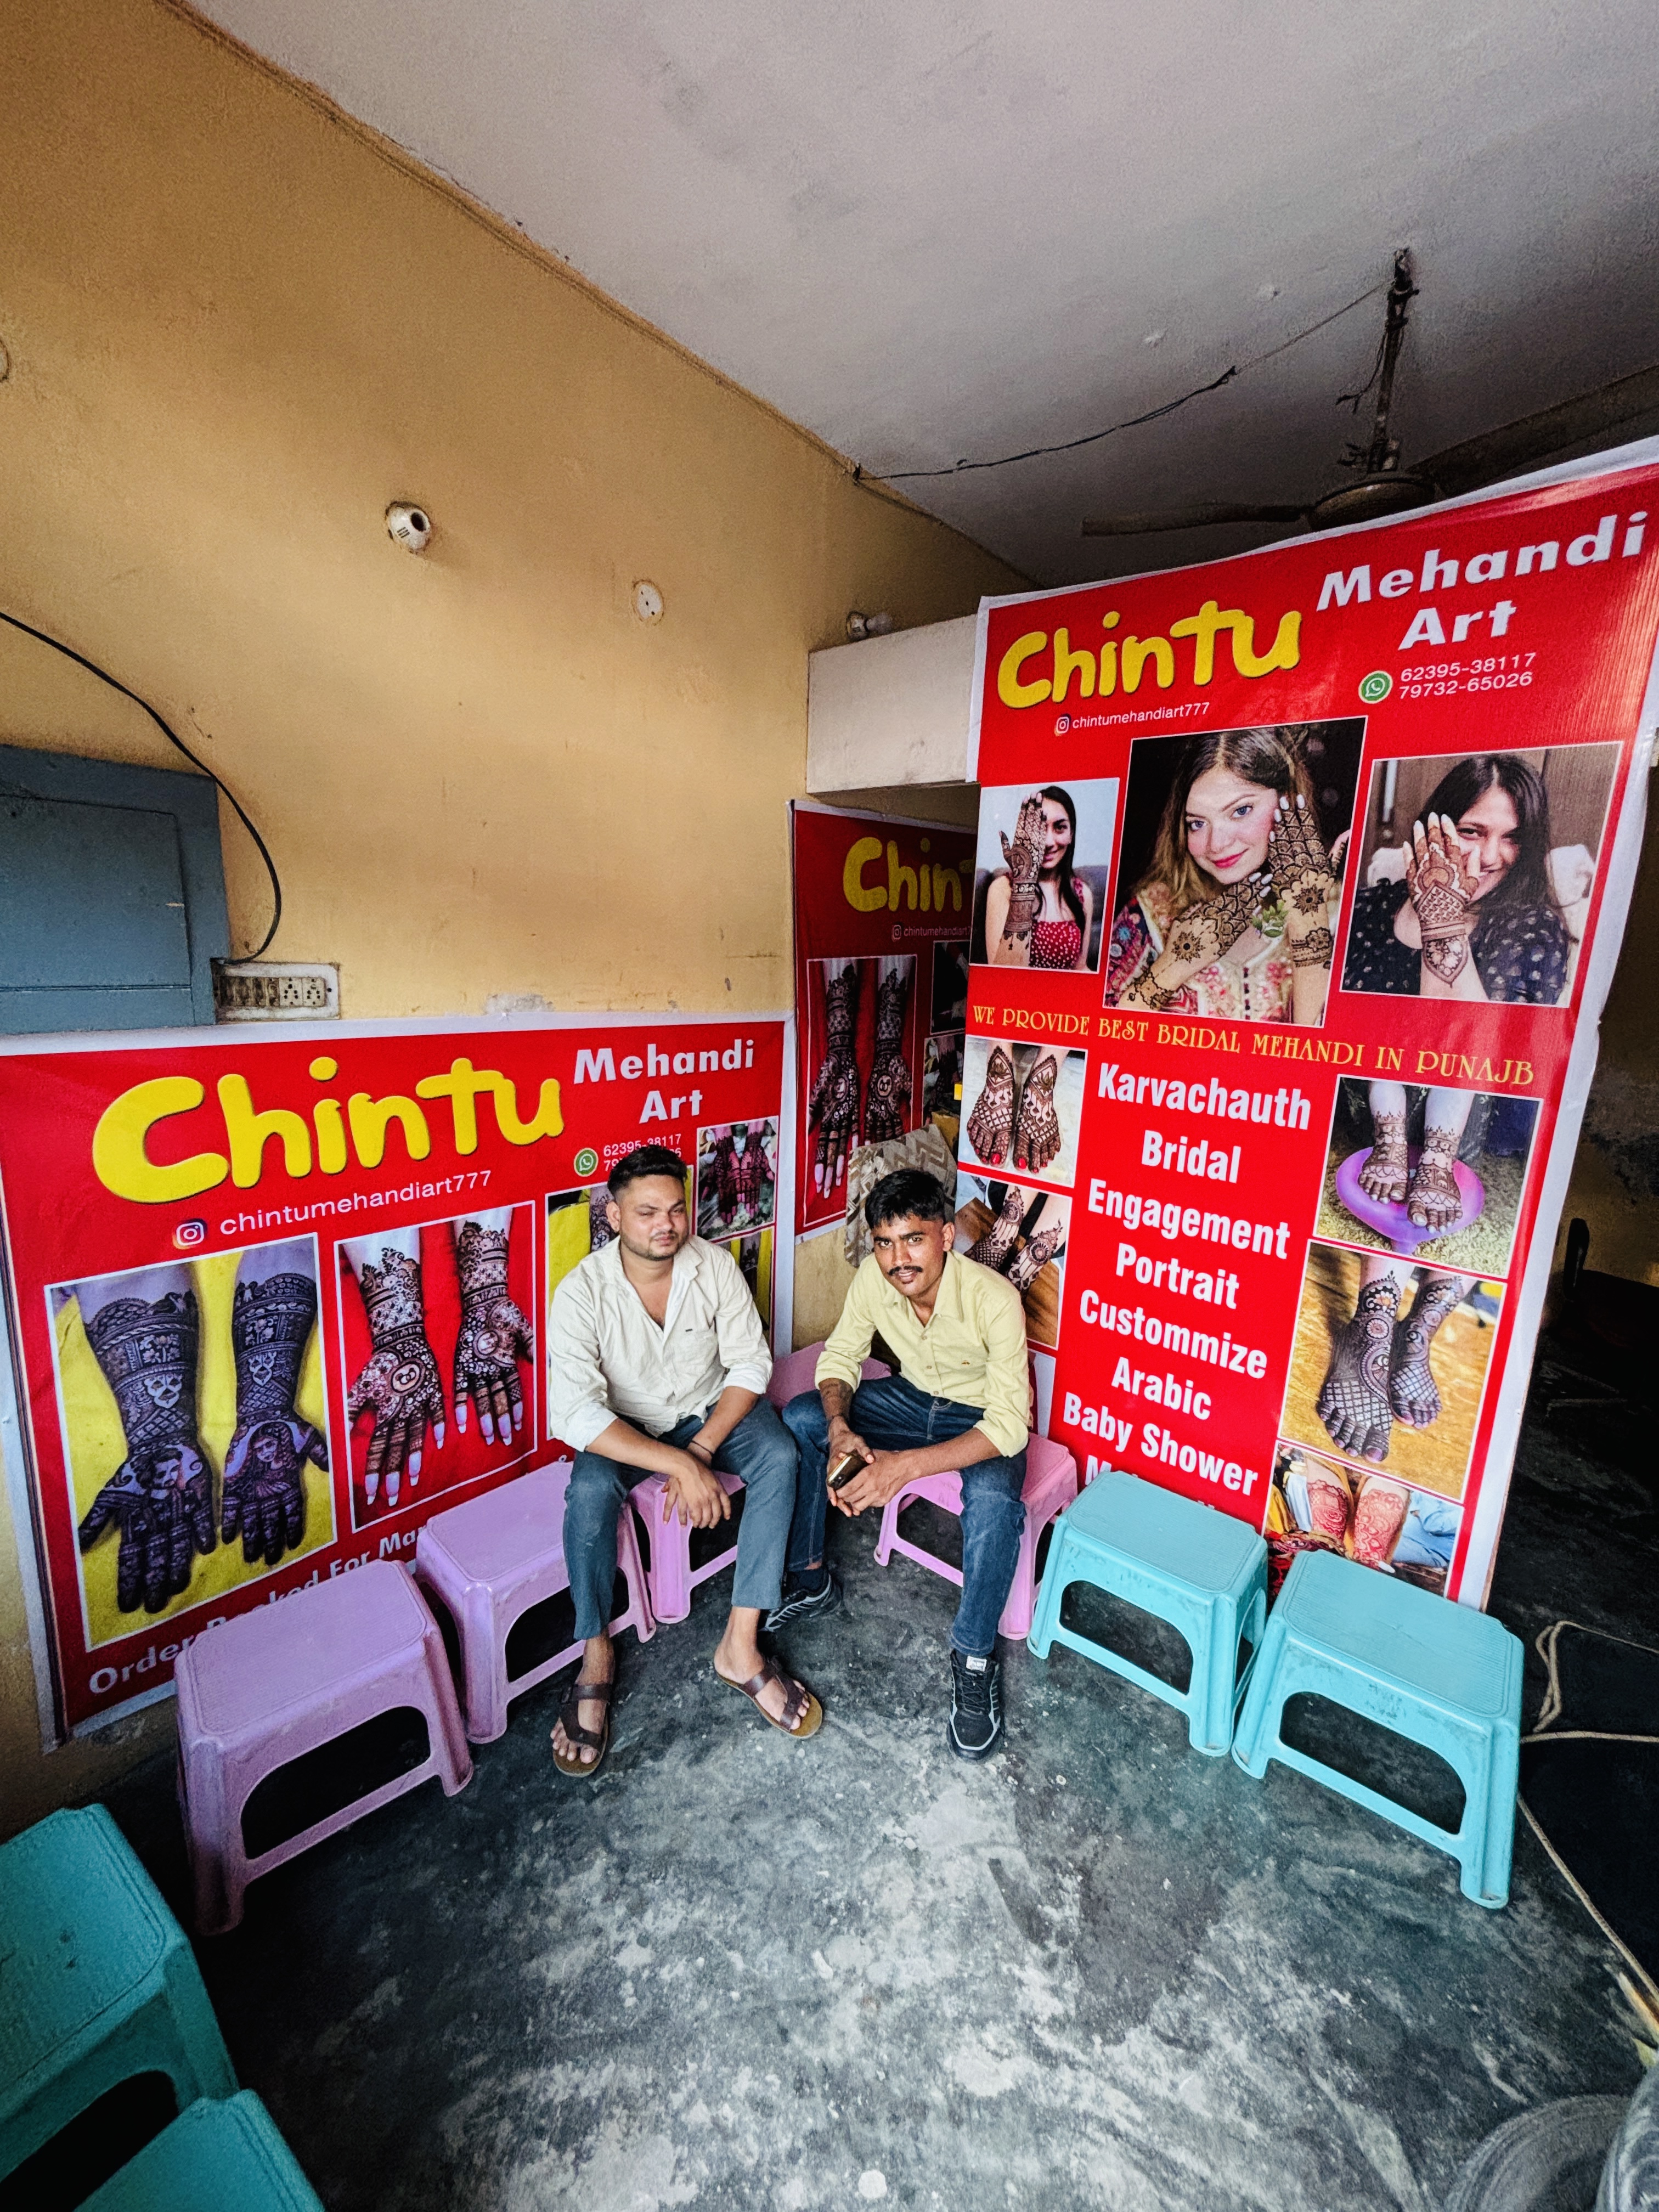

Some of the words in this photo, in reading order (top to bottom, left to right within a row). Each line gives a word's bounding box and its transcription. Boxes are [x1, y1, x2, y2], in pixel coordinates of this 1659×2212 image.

[1317, 511, 1647, 612] Mehandi
[997, 600, 1302, 709] Chintu
[1398, 600, 1517, 651] Art
[1399, 671, 1533, 699] 79732-65026
[1400, 652, 1536, 682] 62395-38117
[1072, 702, 1210, 730] chintumehandiart777
[573, 1039, 755, 1085] Mehandi
[973, 1005, 995, 1025] WE
[1002, 1008, 1090, 1036] PROVIDE
[1098, 1018, 1149, 1042] BEST
[1156, 1024, 1240, 1054] BRIDAL
[1252, 1034, 1366, 1066] MEHANDI
[1375, 1047, 1405, 1071] IN
[1415, 1051, 1534, 1086] PUNAJB
[639, 1089, 703, 1124] Art
[1098, 1062, 1312, 1130] Karvachauth
[92, 1057, 565, 1204] Chintu
[1141, 1129, 1242, 1184] Bridal
[220, 1170, 492, 1236] chintumehandiart777
[1088, 1177, 1290, 1260] Engagement
[1115, 1242, 1240, 1310] Portrait
[1080, 1289, 1267, 1379] Custommize
[1111, 1356, 1212, 1420] Arabic
[1063, 1391, 1133, 1453] Baby
[1141, 1423, 1259, 1497] Shower
[88, 1634, 194, 1695] Order
[329, 1550, 370, 1578] For
